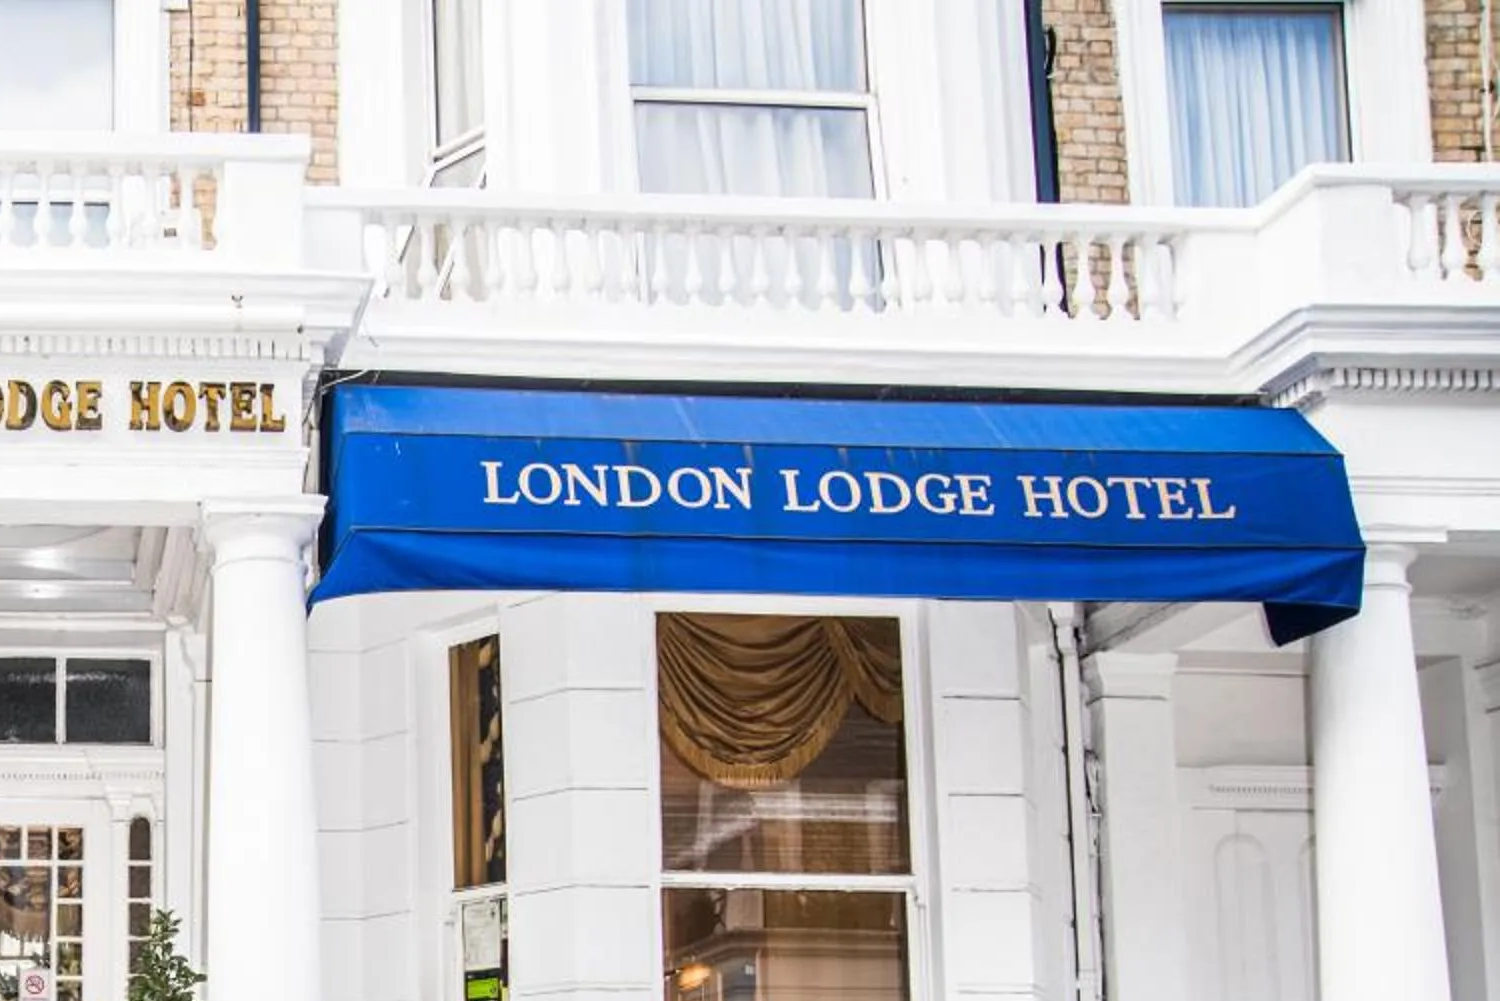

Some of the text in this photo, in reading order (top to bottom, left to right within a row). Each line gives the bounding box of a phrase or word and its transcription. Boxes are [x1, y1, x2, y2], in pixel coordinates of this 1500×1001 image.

[130, 381, 287, 434] HOTEL
[482, 461, 1237, 520] LONDON LODGE HOTEL
